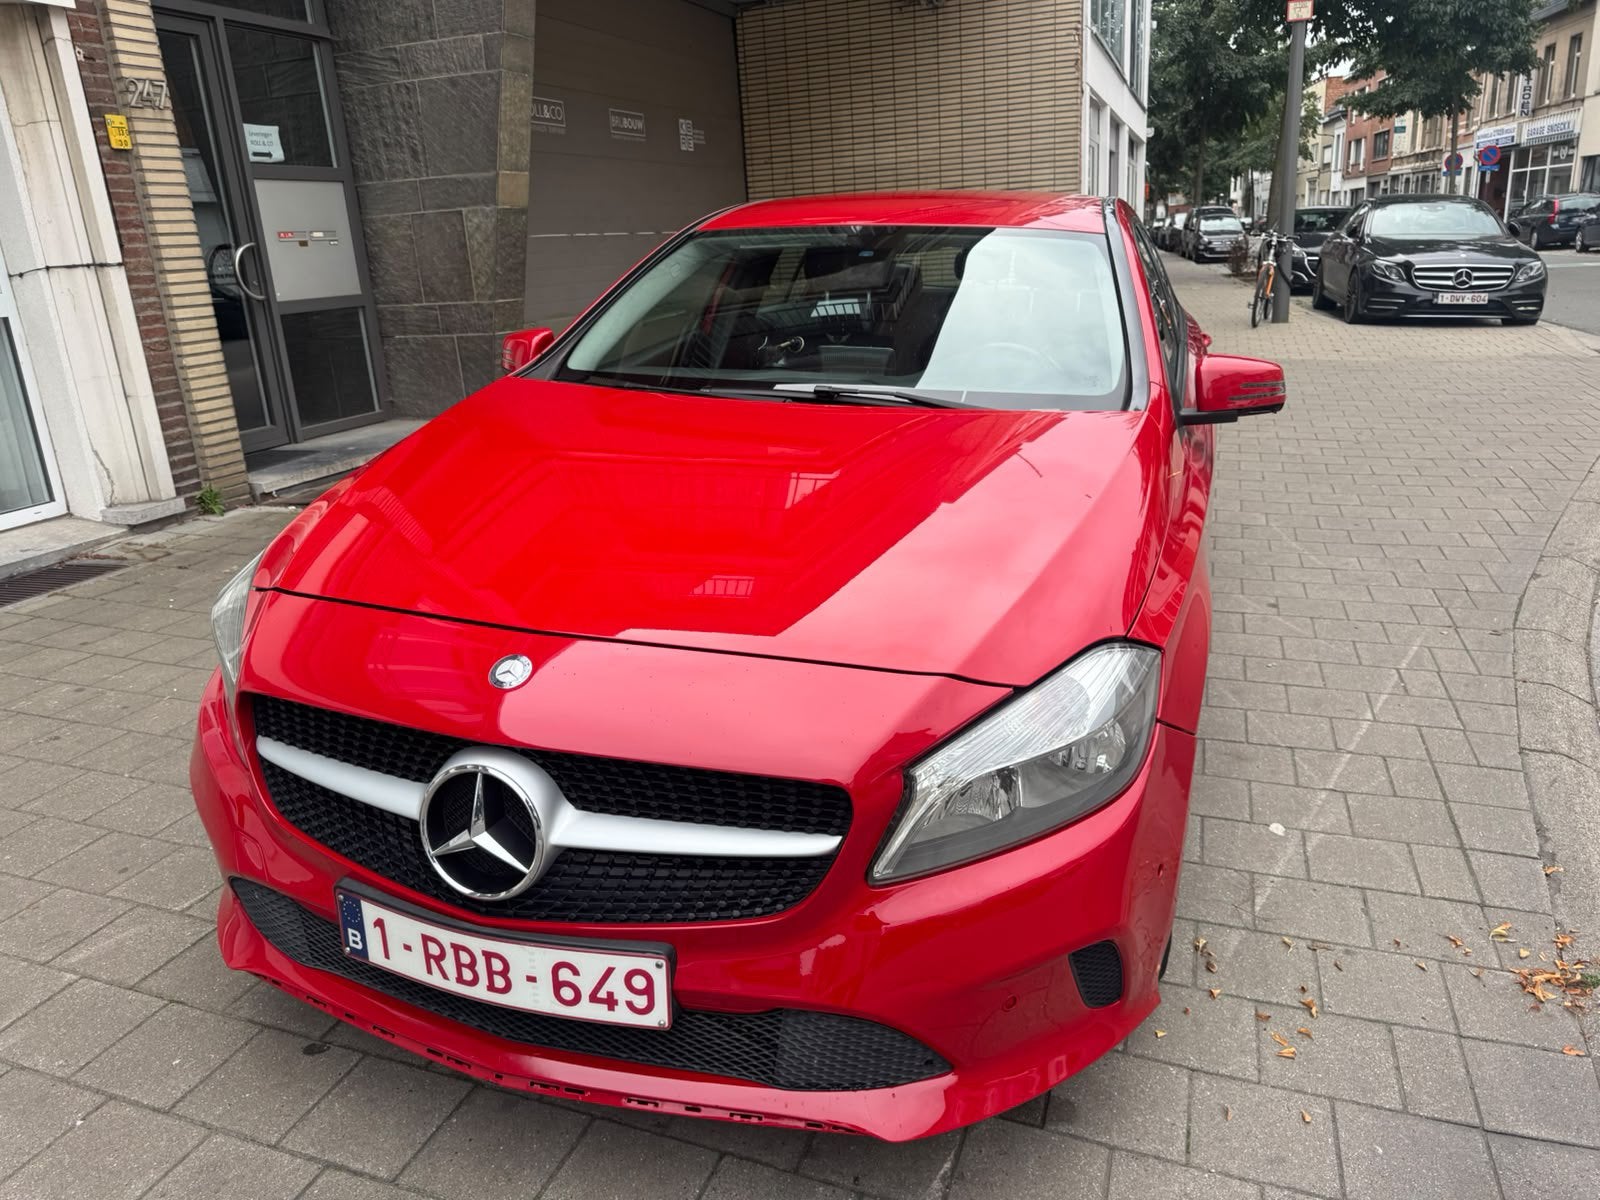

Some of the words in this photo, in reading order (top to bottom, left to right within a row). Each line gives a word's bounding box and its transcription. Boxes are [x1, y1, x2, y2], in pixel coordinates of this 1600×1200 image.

[125, 78, 167, 110] 247
[1520, 78, 1532, 116] TROËN
[529, 103, 563, 121] OLL&CO
[1526, 125, 1546, 138] GARAGE
[346, 927, 363, 950] B
[372, 917, 656, 1016] 1-RBB-649
